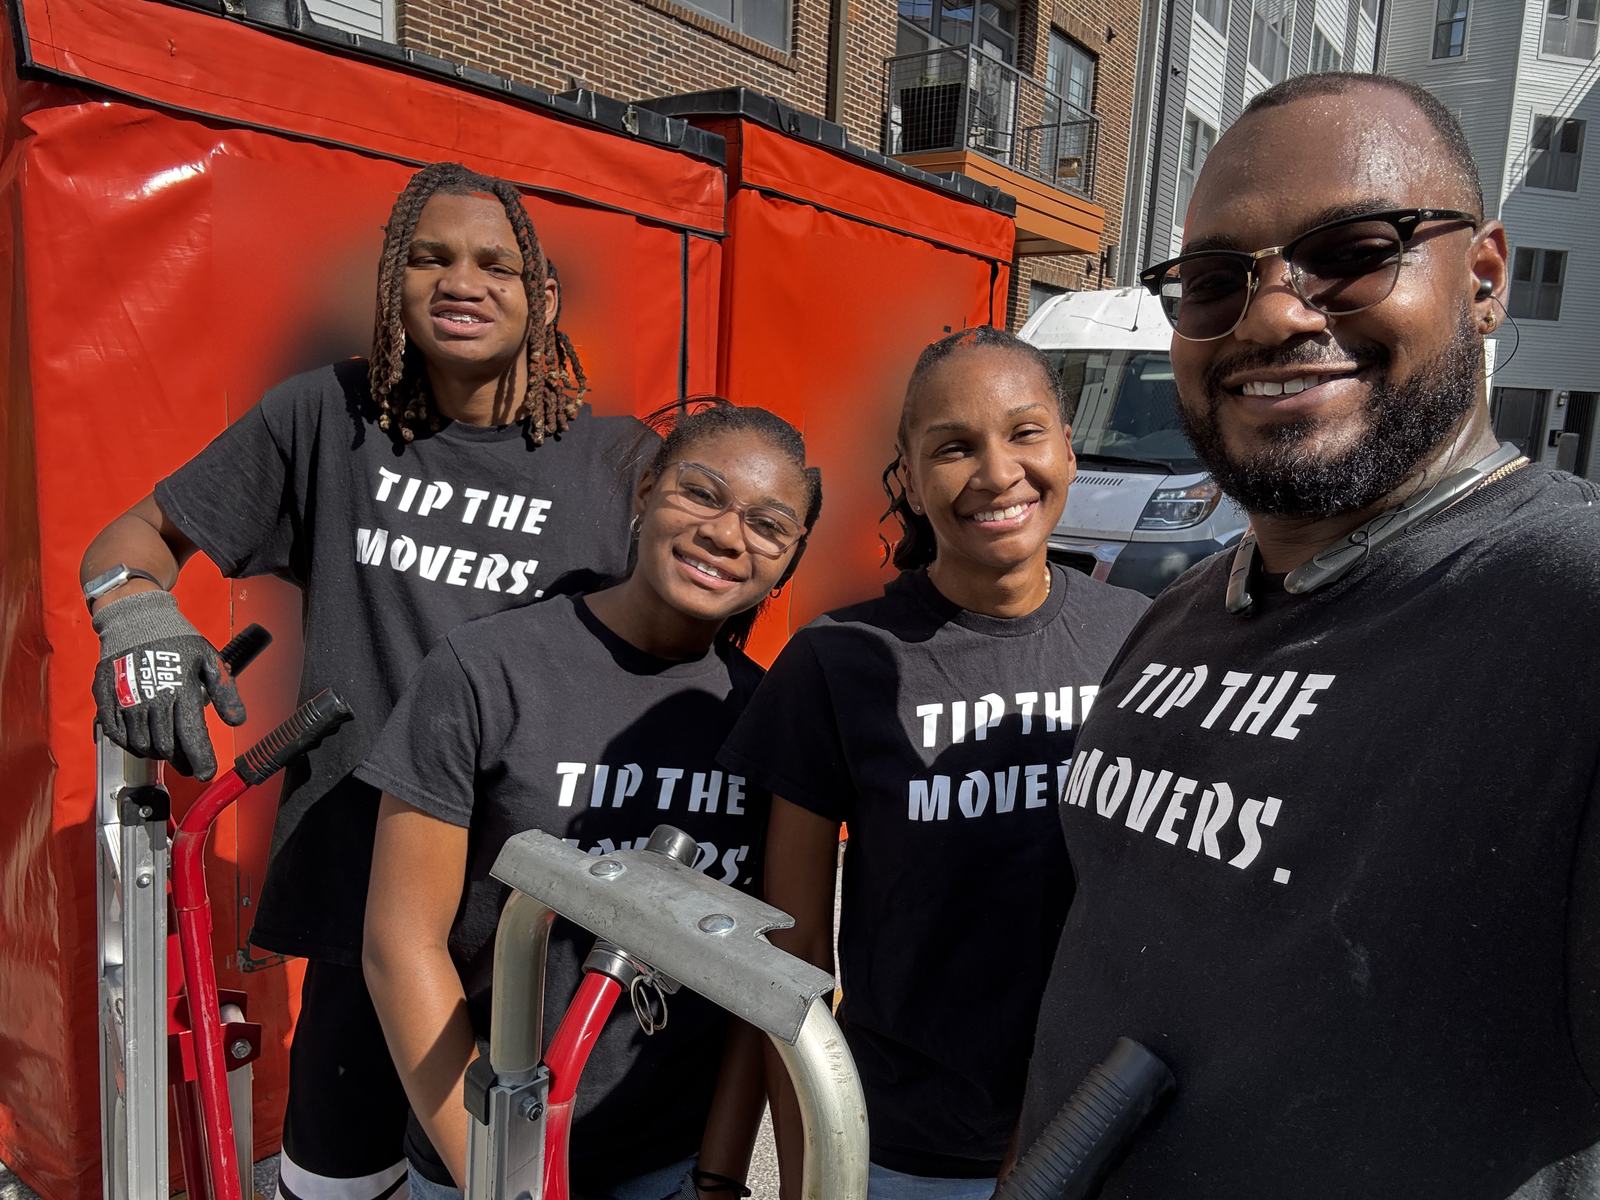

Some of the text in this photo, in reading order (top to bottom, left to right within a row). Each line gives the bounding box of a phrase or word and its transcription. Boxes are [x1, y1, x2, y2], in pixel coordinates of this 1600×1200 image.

[375, 466, 553, 535] TIP THE
[355, 528, 544, 598] MOVERS.
[139, 667, 156, 700] PIP
[156, 650, 183, 692] G-Tek
[1117, 663, 1336, 740] TIP THE
[916, 692, 1006, 748] TIP
[556, 761, 746, 816] TIP THE
[1064, 748, 1292, 885] MOVERS.
